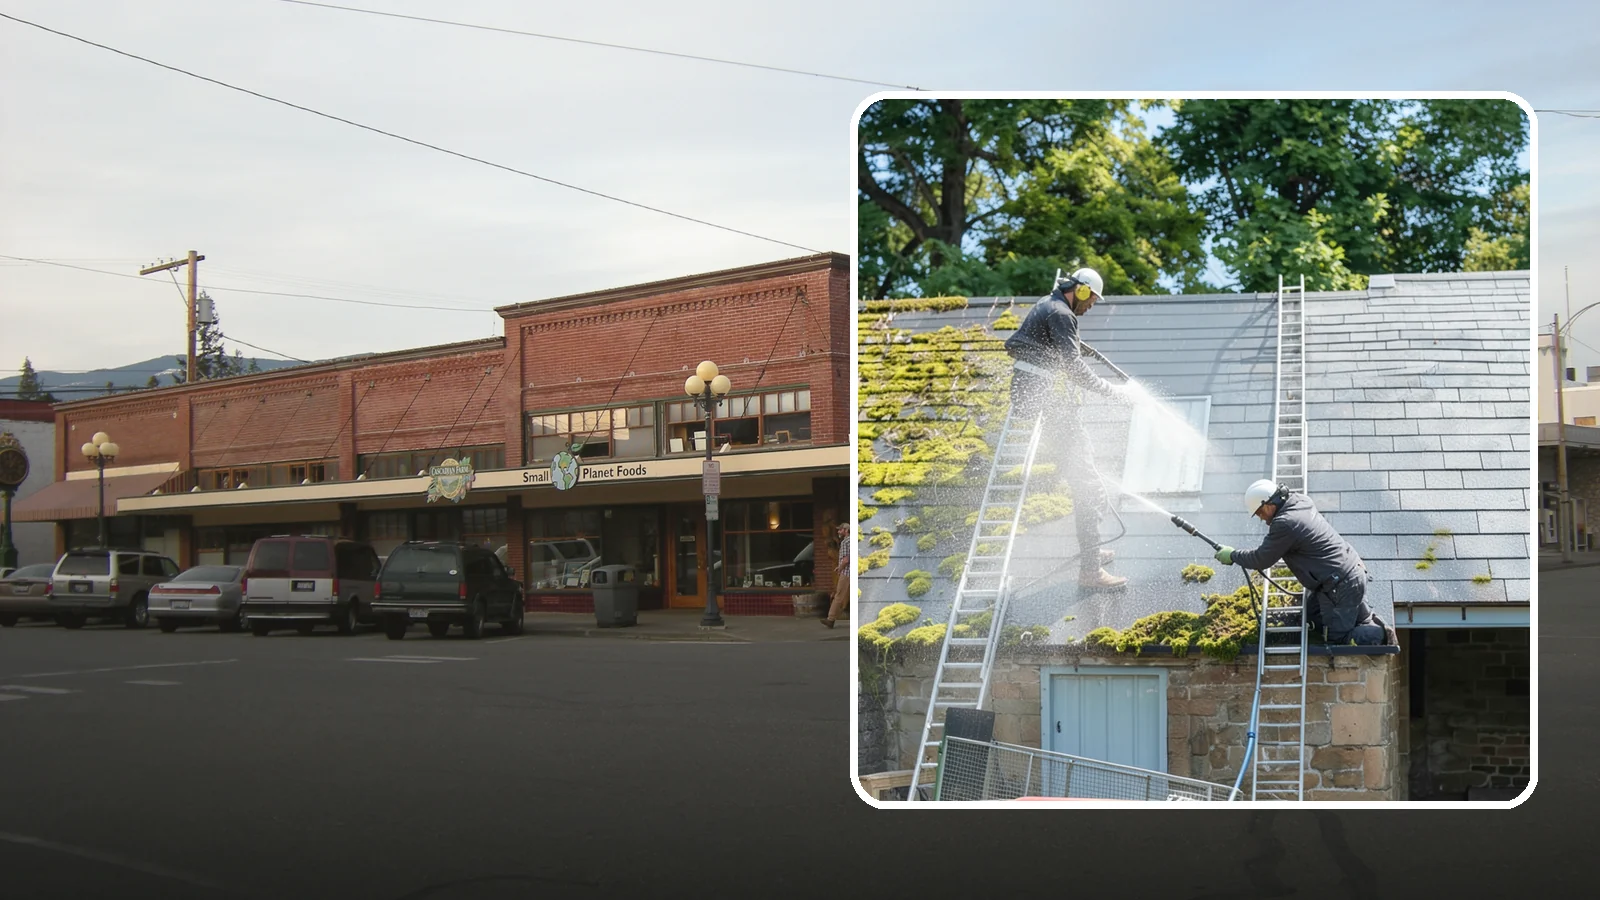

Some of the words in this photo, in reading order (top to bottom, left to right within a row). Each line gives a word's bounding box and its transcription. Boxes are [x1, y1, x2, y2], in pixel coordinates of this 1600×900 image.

[523, 471, 549, 483] Small
[583, 468, 614, 479] Planet
[617, 464, 647, 477] Foods
